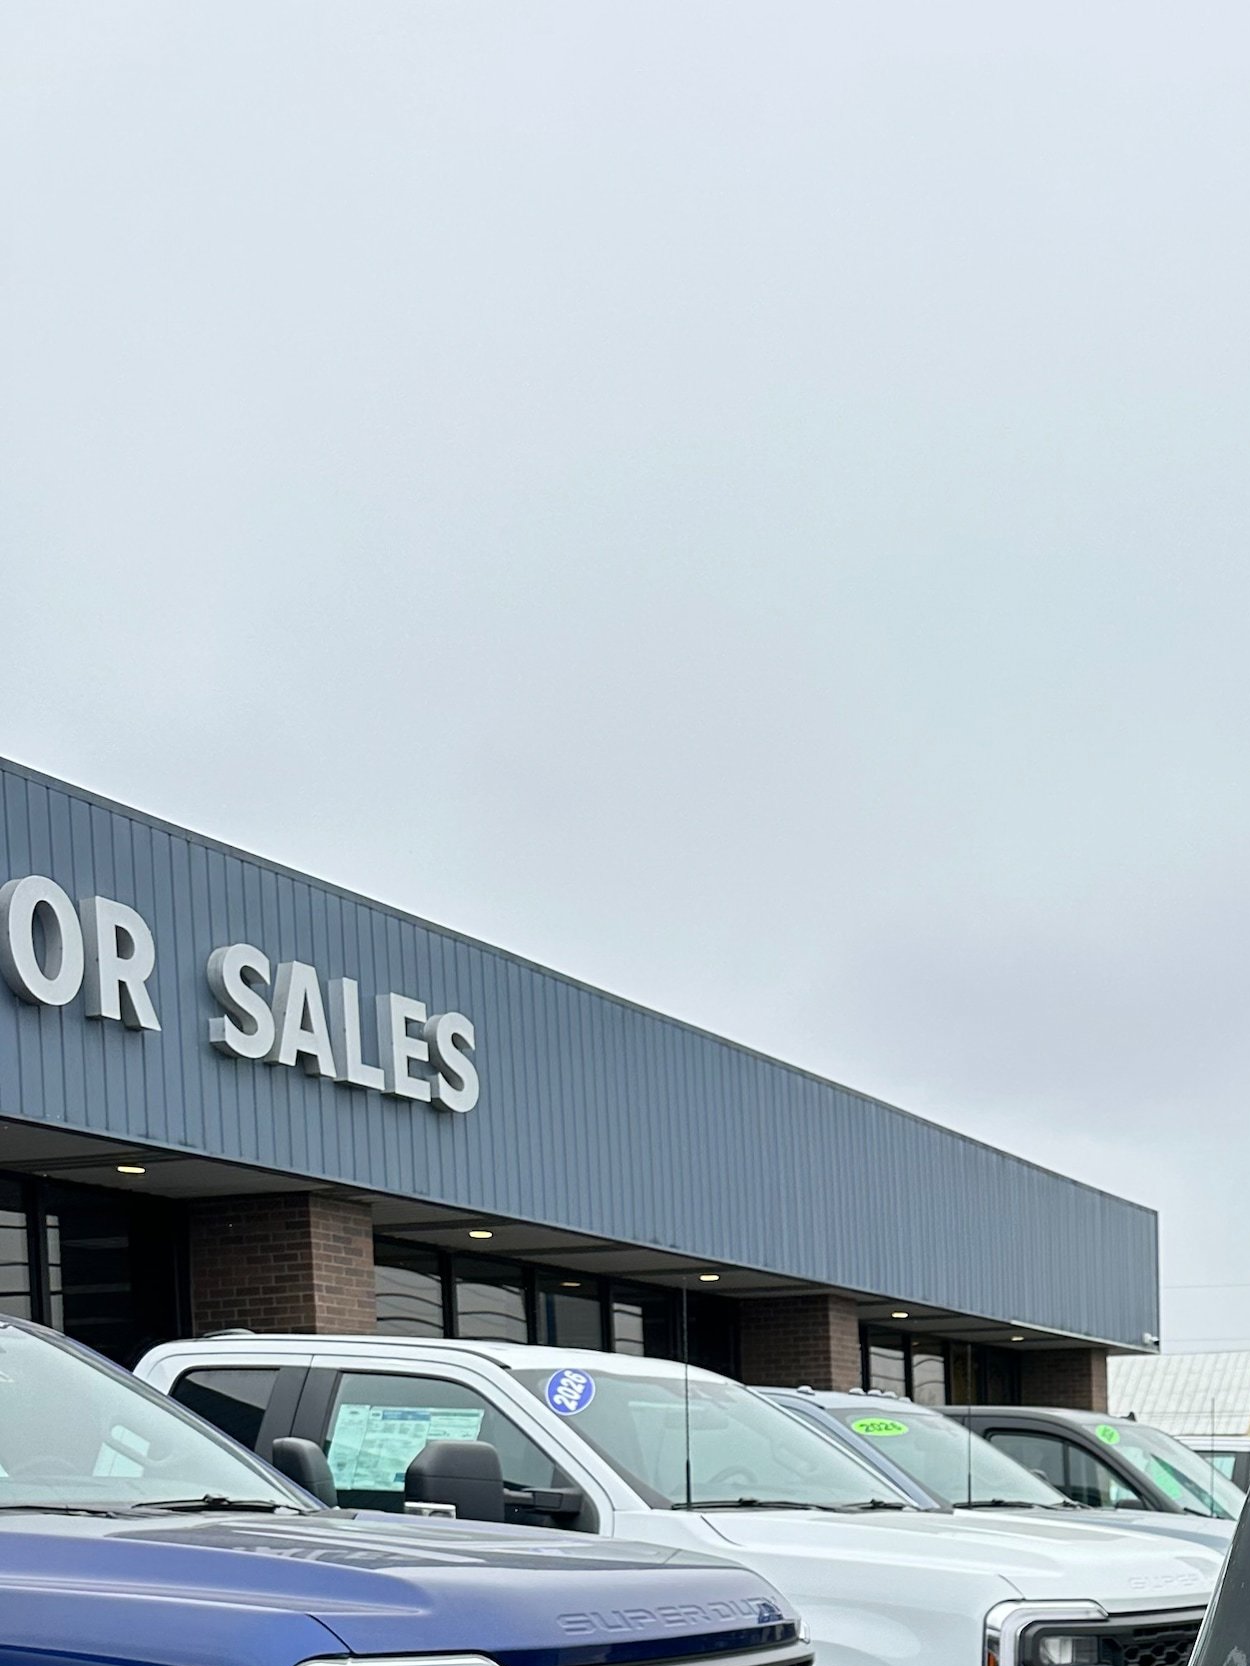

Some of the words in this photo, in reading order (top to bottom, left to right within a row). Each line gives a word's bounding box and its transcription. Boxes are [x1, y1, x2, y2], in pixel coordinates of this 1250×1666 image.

[0, 874, 162, 1032] OR
[207, 942, 481, 1114] SALES
[552, 1370, 588, 1411] 2026
